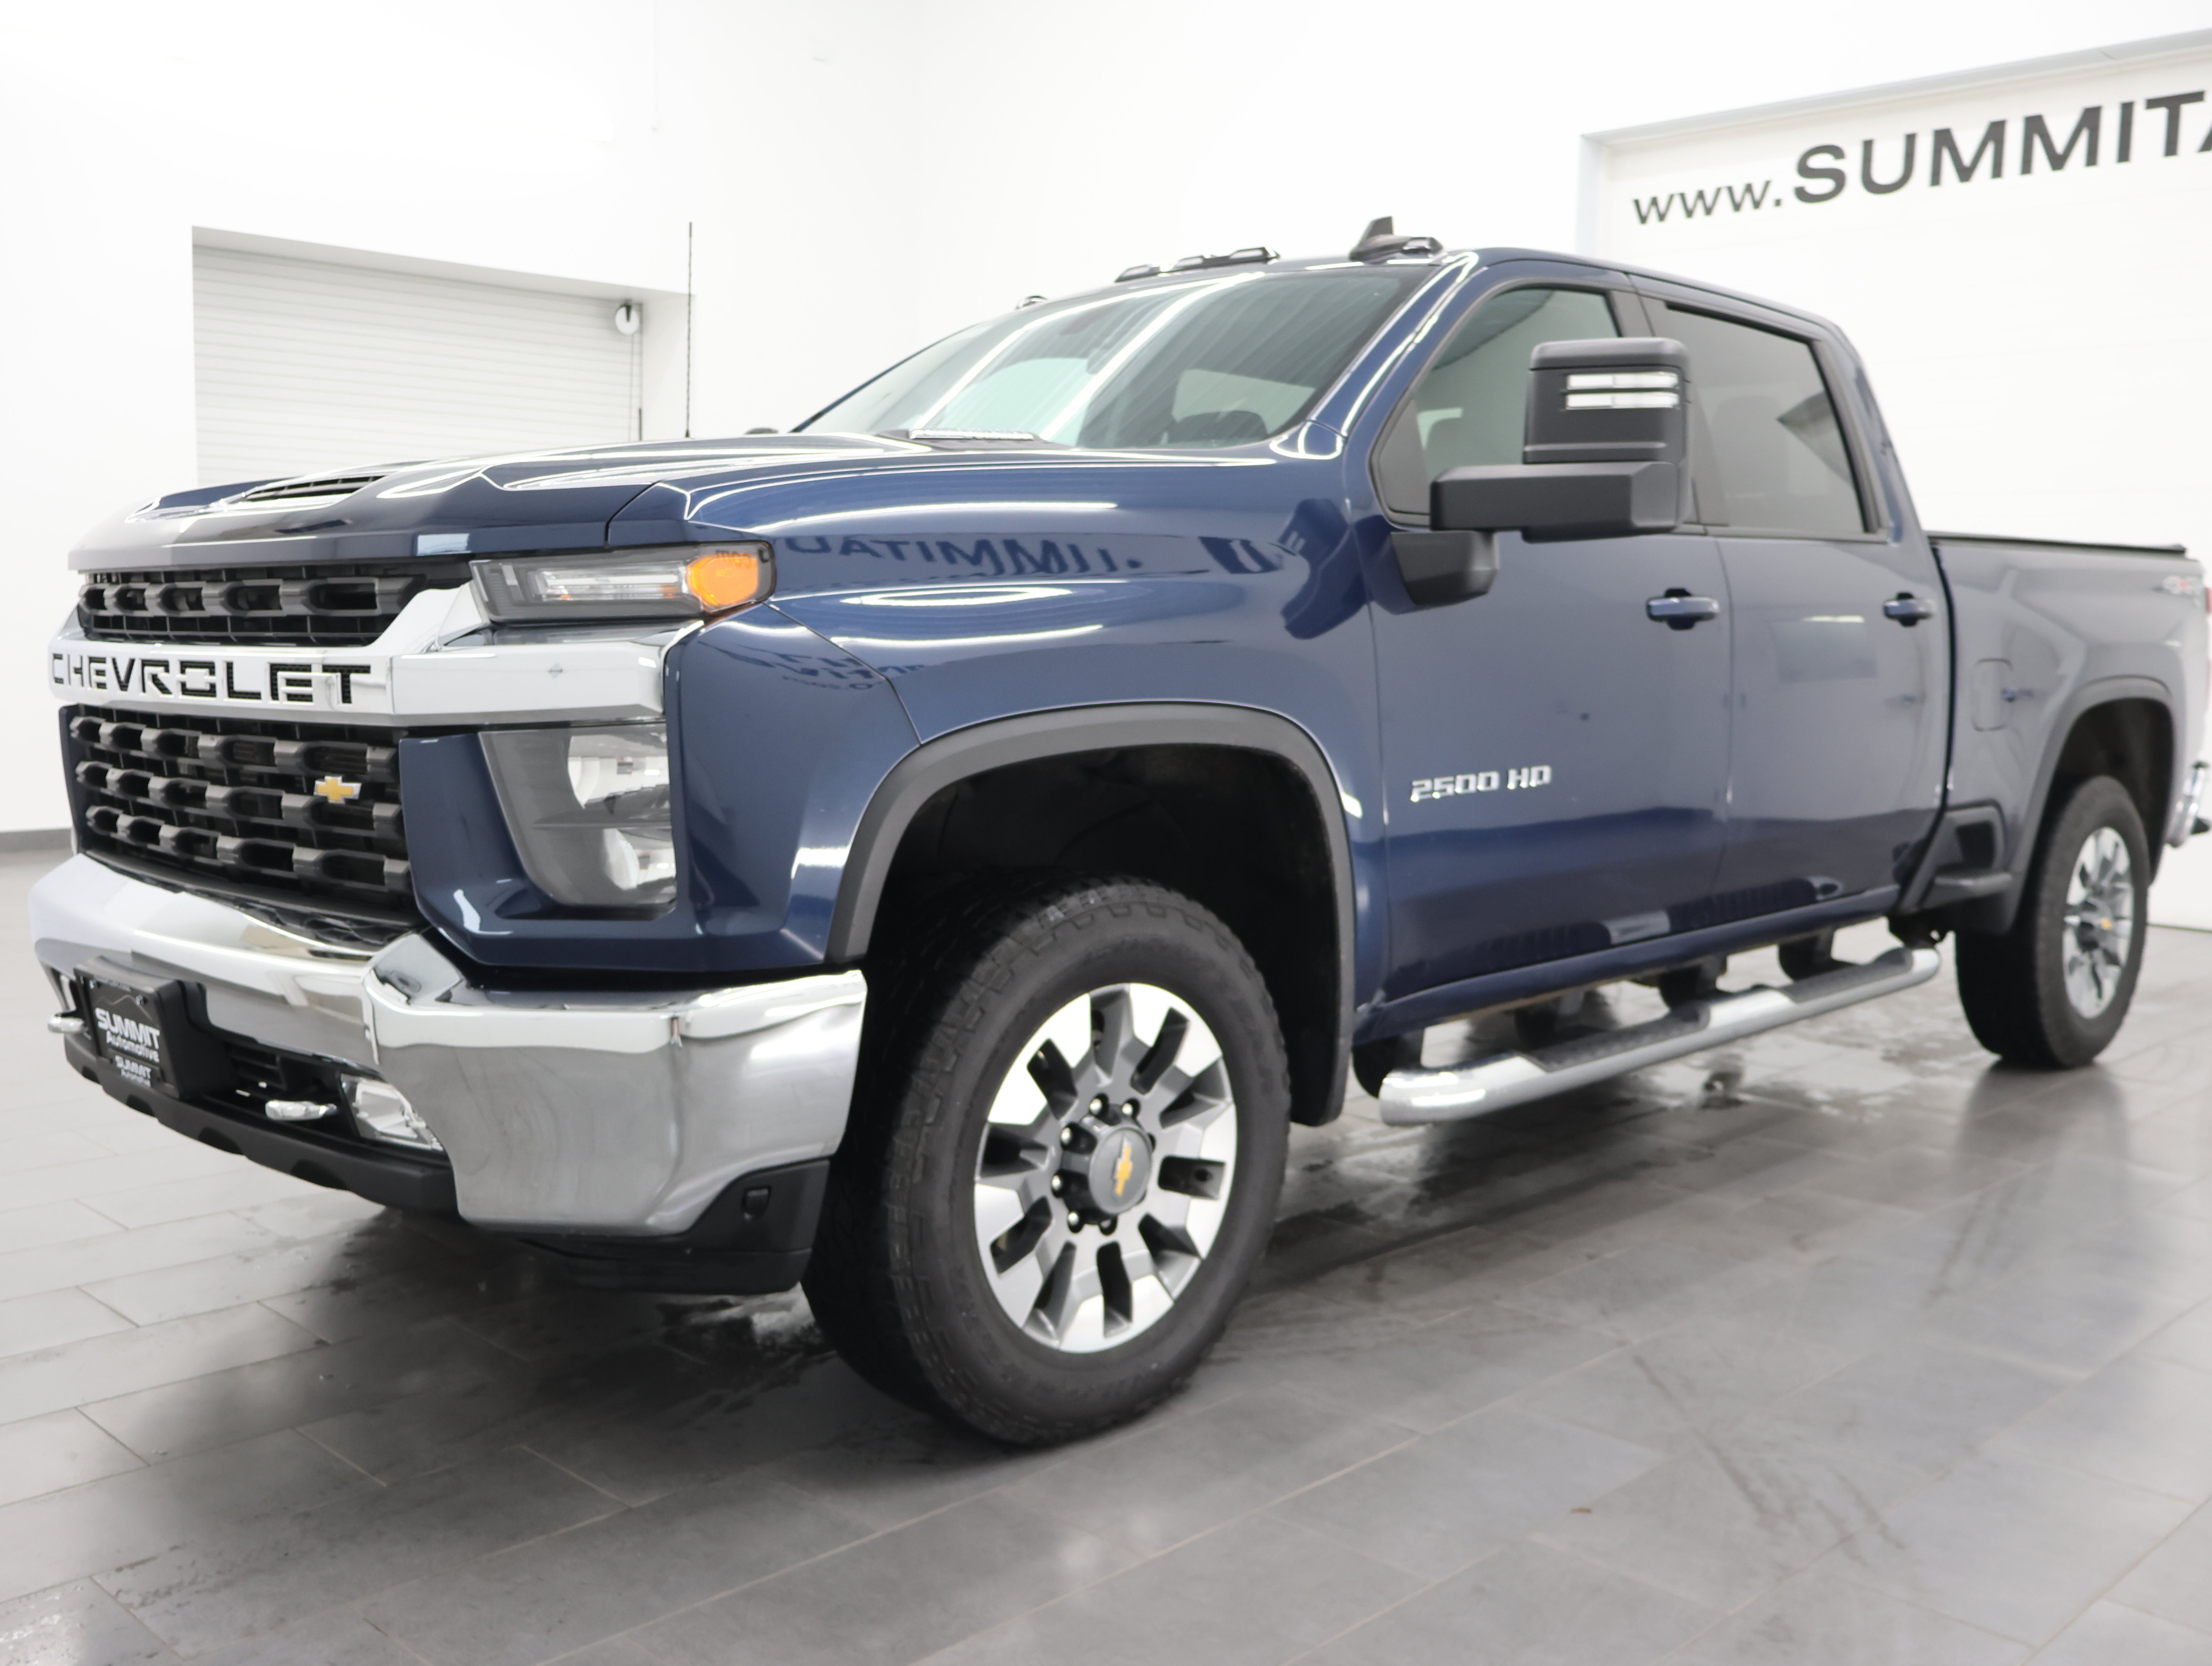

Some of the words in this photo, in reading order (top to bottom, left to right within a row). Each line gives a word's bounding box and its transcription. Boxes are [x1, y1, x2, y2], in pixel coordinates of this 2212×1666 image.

[1633, 90, 2212, 225] www.SUMMIT
[52, 653, 371, 704] CHEVROLET
[1410, 771, 1500, 802] 2500
[1507, 764, 1552, 789] HD
[95, 1007, 160, 1050] SUMMIT
